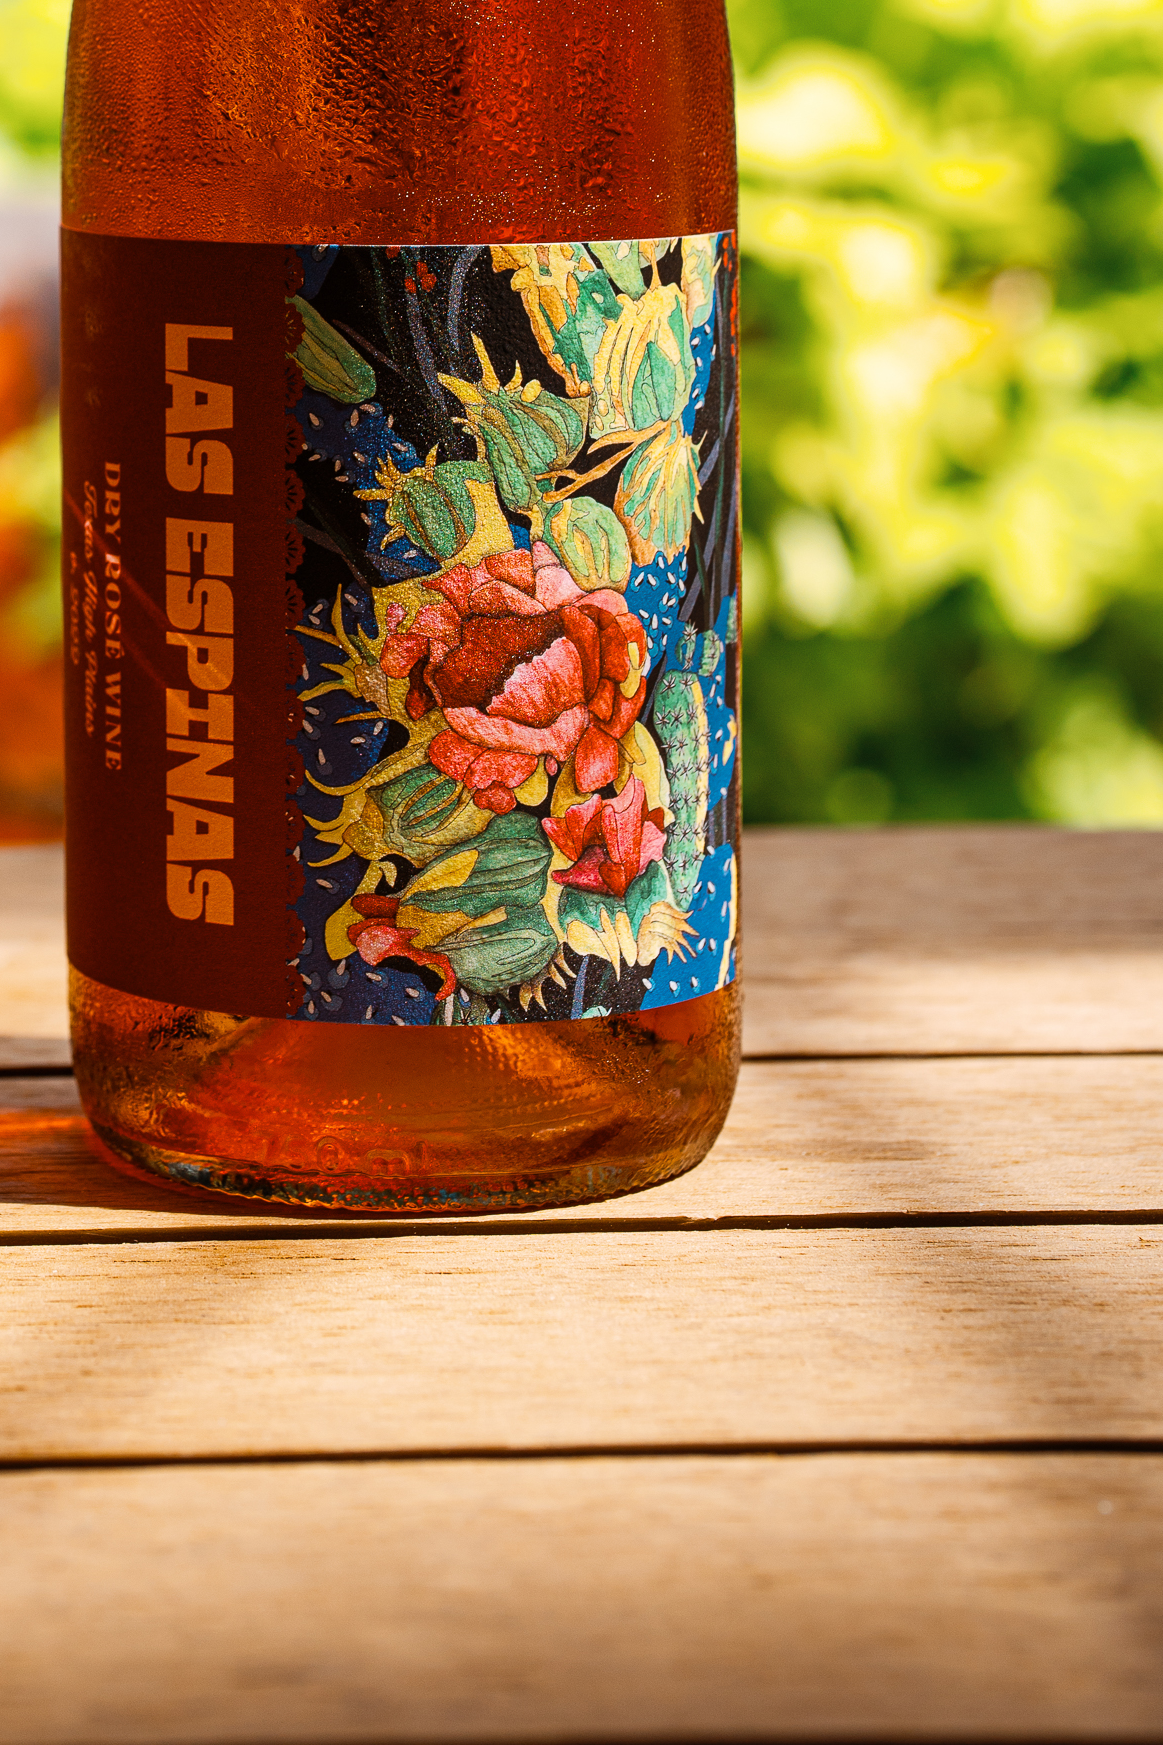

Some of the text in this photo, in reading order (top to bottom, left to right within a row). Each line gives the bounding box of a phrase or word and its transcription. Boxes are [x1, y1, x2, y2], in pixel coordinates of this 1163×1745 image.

[83, 480, 98, 737] Texas High Plains
[105, 462, 125, 770] DRY ROSÉ WINE
[165, 323, 234, 926] LAS ESPINAS
